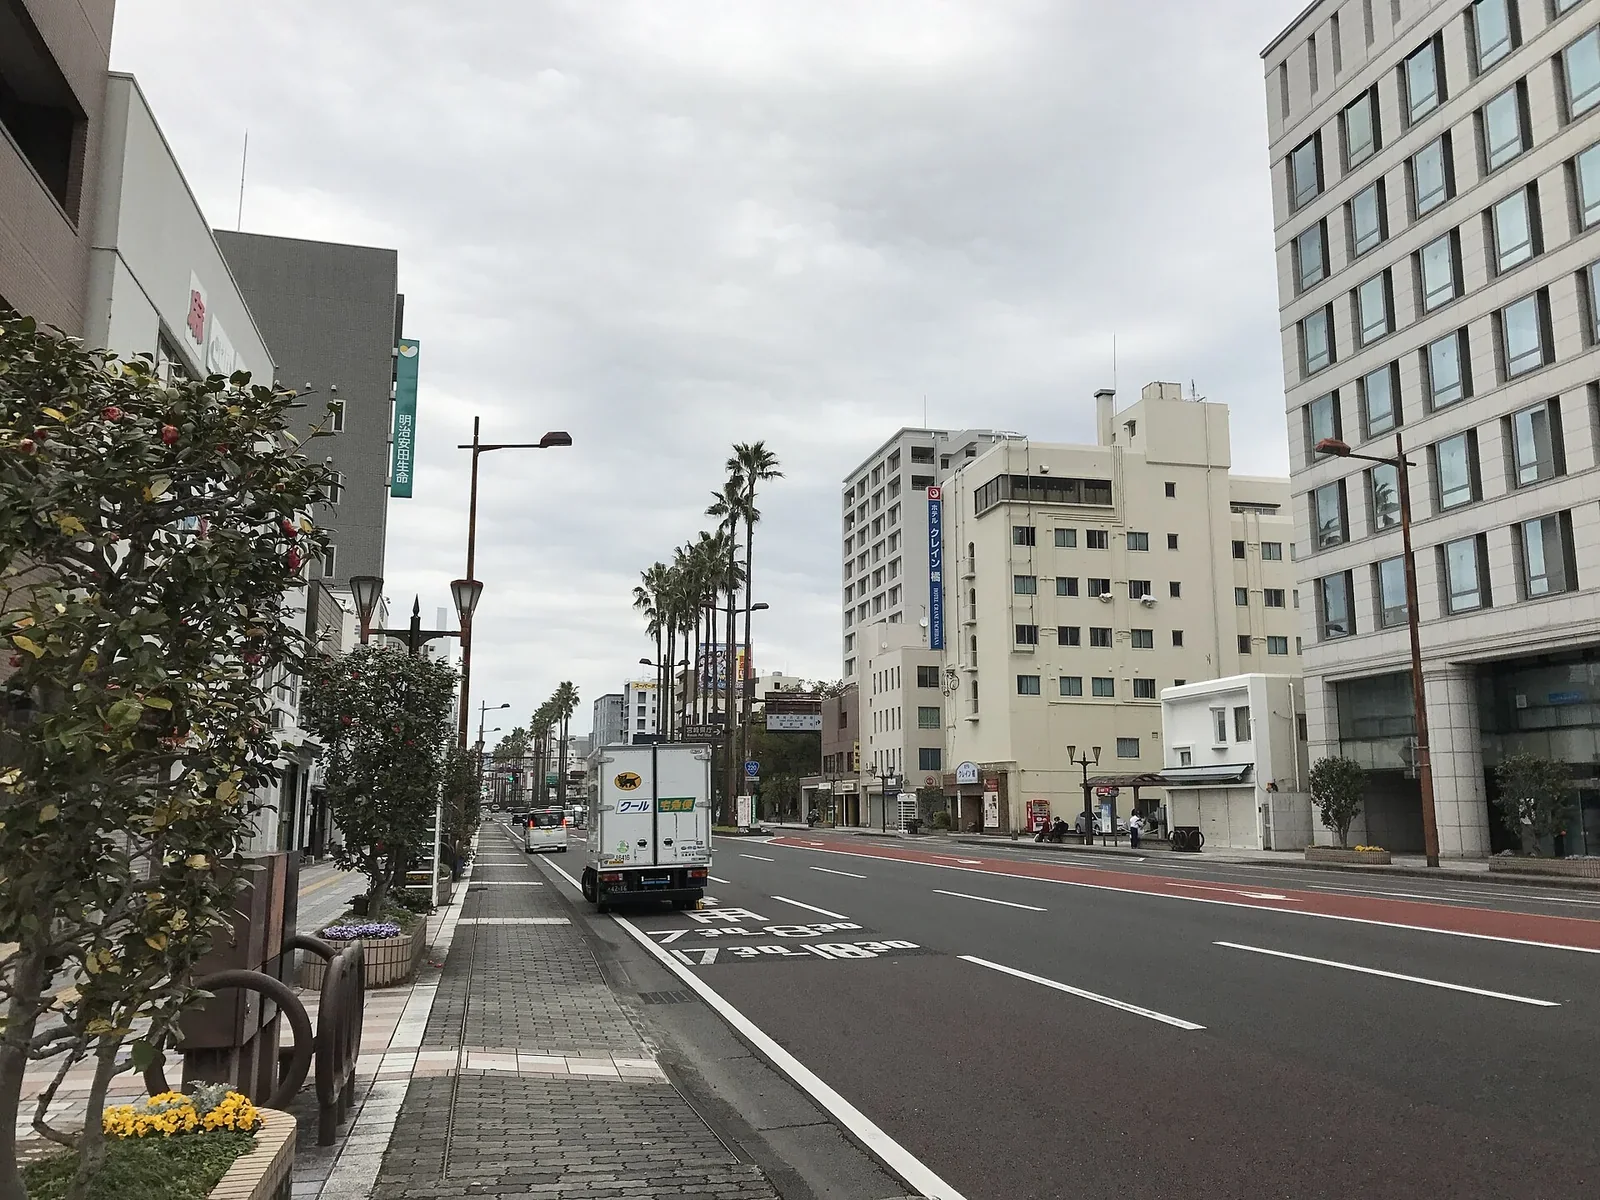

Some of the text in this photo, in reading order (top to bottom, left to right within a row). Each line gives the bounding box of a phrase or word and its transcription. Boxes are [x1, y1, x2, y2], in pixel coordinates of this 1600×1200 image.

[396, 414, 412, 484] 明治安田生命
[931, 504, 939, 524] ホテル
[620, 799, 693, 812] クール 宅急便
